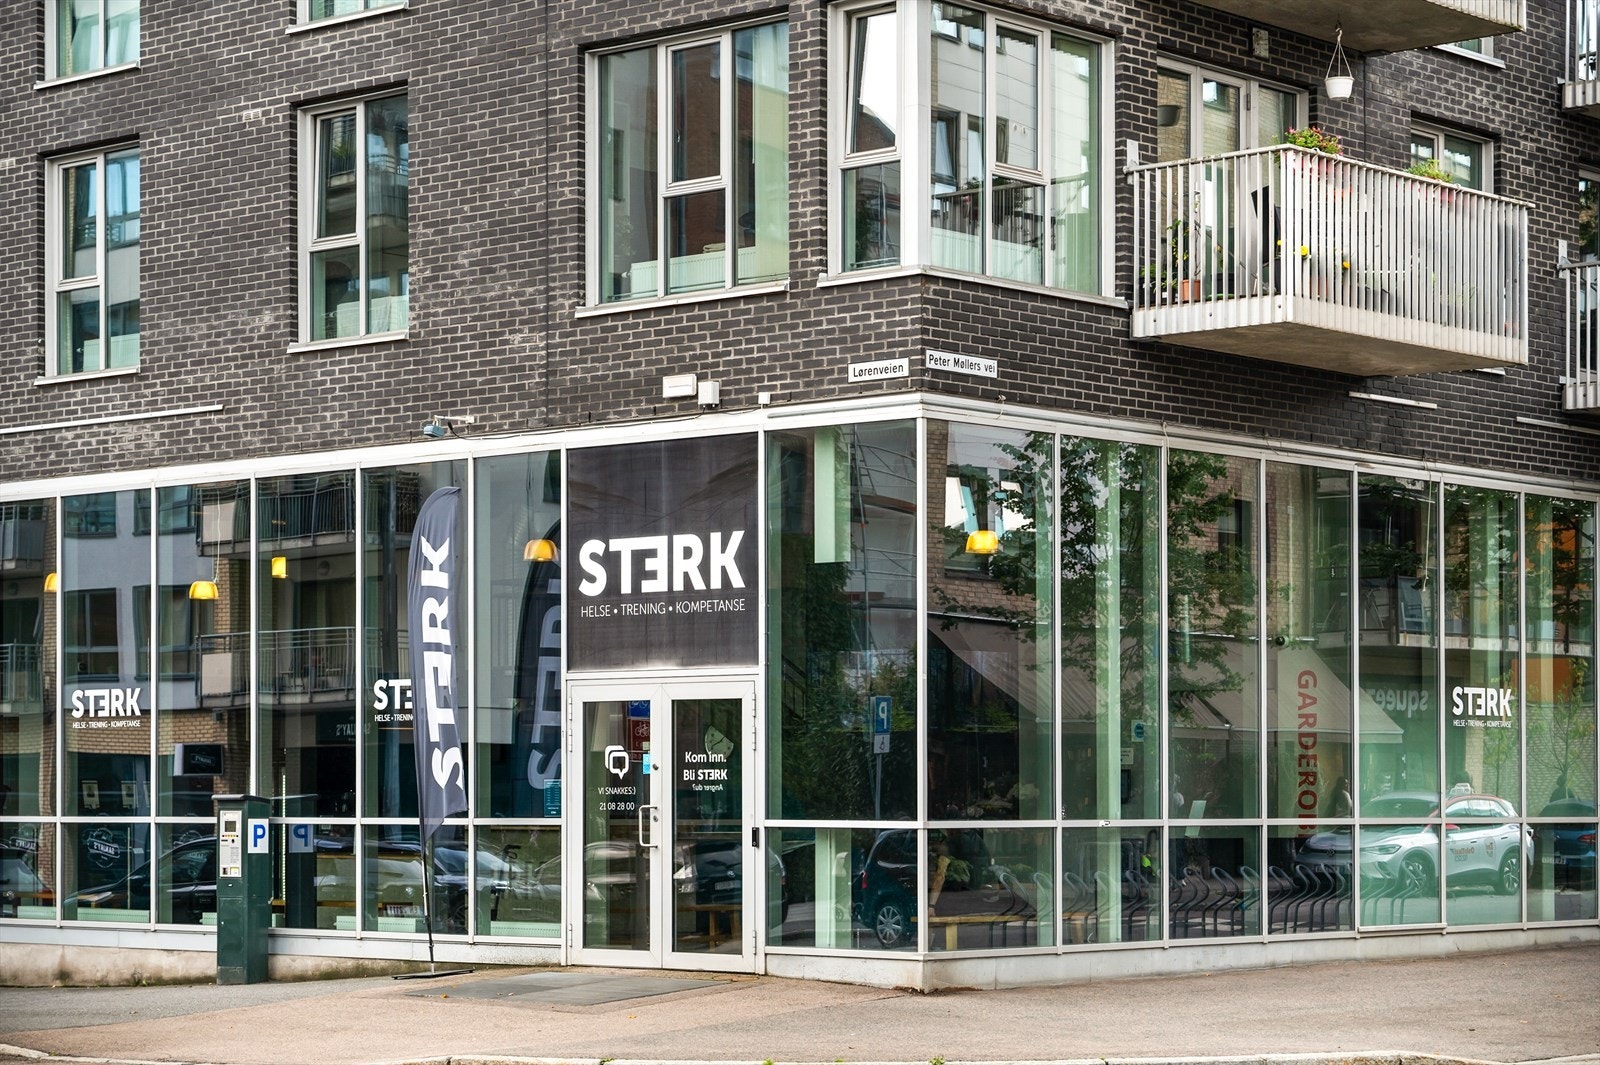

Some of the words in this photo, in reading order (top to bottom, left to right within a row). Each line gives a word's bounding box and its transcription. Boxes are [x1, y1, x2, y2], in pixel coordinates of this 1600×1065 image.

[853, 363, 904, 378] Lørenveien
[928, 353, 951, 367] Peter
[953, 357, 981, 371] Møllers
[984, 362, 996, 373] vei
[578, 530, 746, 597] STERK
[581, 604, 611, 618] HELSE
[620, 602, 666, 616] TRENING
[675, 598, 746, 614] KOMPETANSE
[71, 687, 142, 719] STERK
[373, 678, 413, 711] STE
[1452, 686, 1513, 717] STERK
[72, 721, 87, 729] HELSE
[88, 720, 109, 729] TRENING
[110, 719, 141, 728] KOMPETANSE
[374, 714, 391, 722] HELSE
[394, 713, 414, 722] TRENIN
[1453, 719, 1466, 728] HELSE
[1467, 719, 1485, 728] TRENING
[1486, 720, 1513, 728] KOMPETANSE
[685, 751, 706, 763] Kom
[707, 751, 727, 763] inn.
[1297, 669, 1318, 838] GARDEROB
[683, 769, 695, 781] Bli
[697, 769, 728, 781] STERK
[597, 786, 604, 795] VI
[599, 802, 607, 811] 21
[607, 802, 616, 811] 08
[616, 802, 625, 811] 28
[625, 802, 635, 811] 00
[253, 824, 267, 848] P
